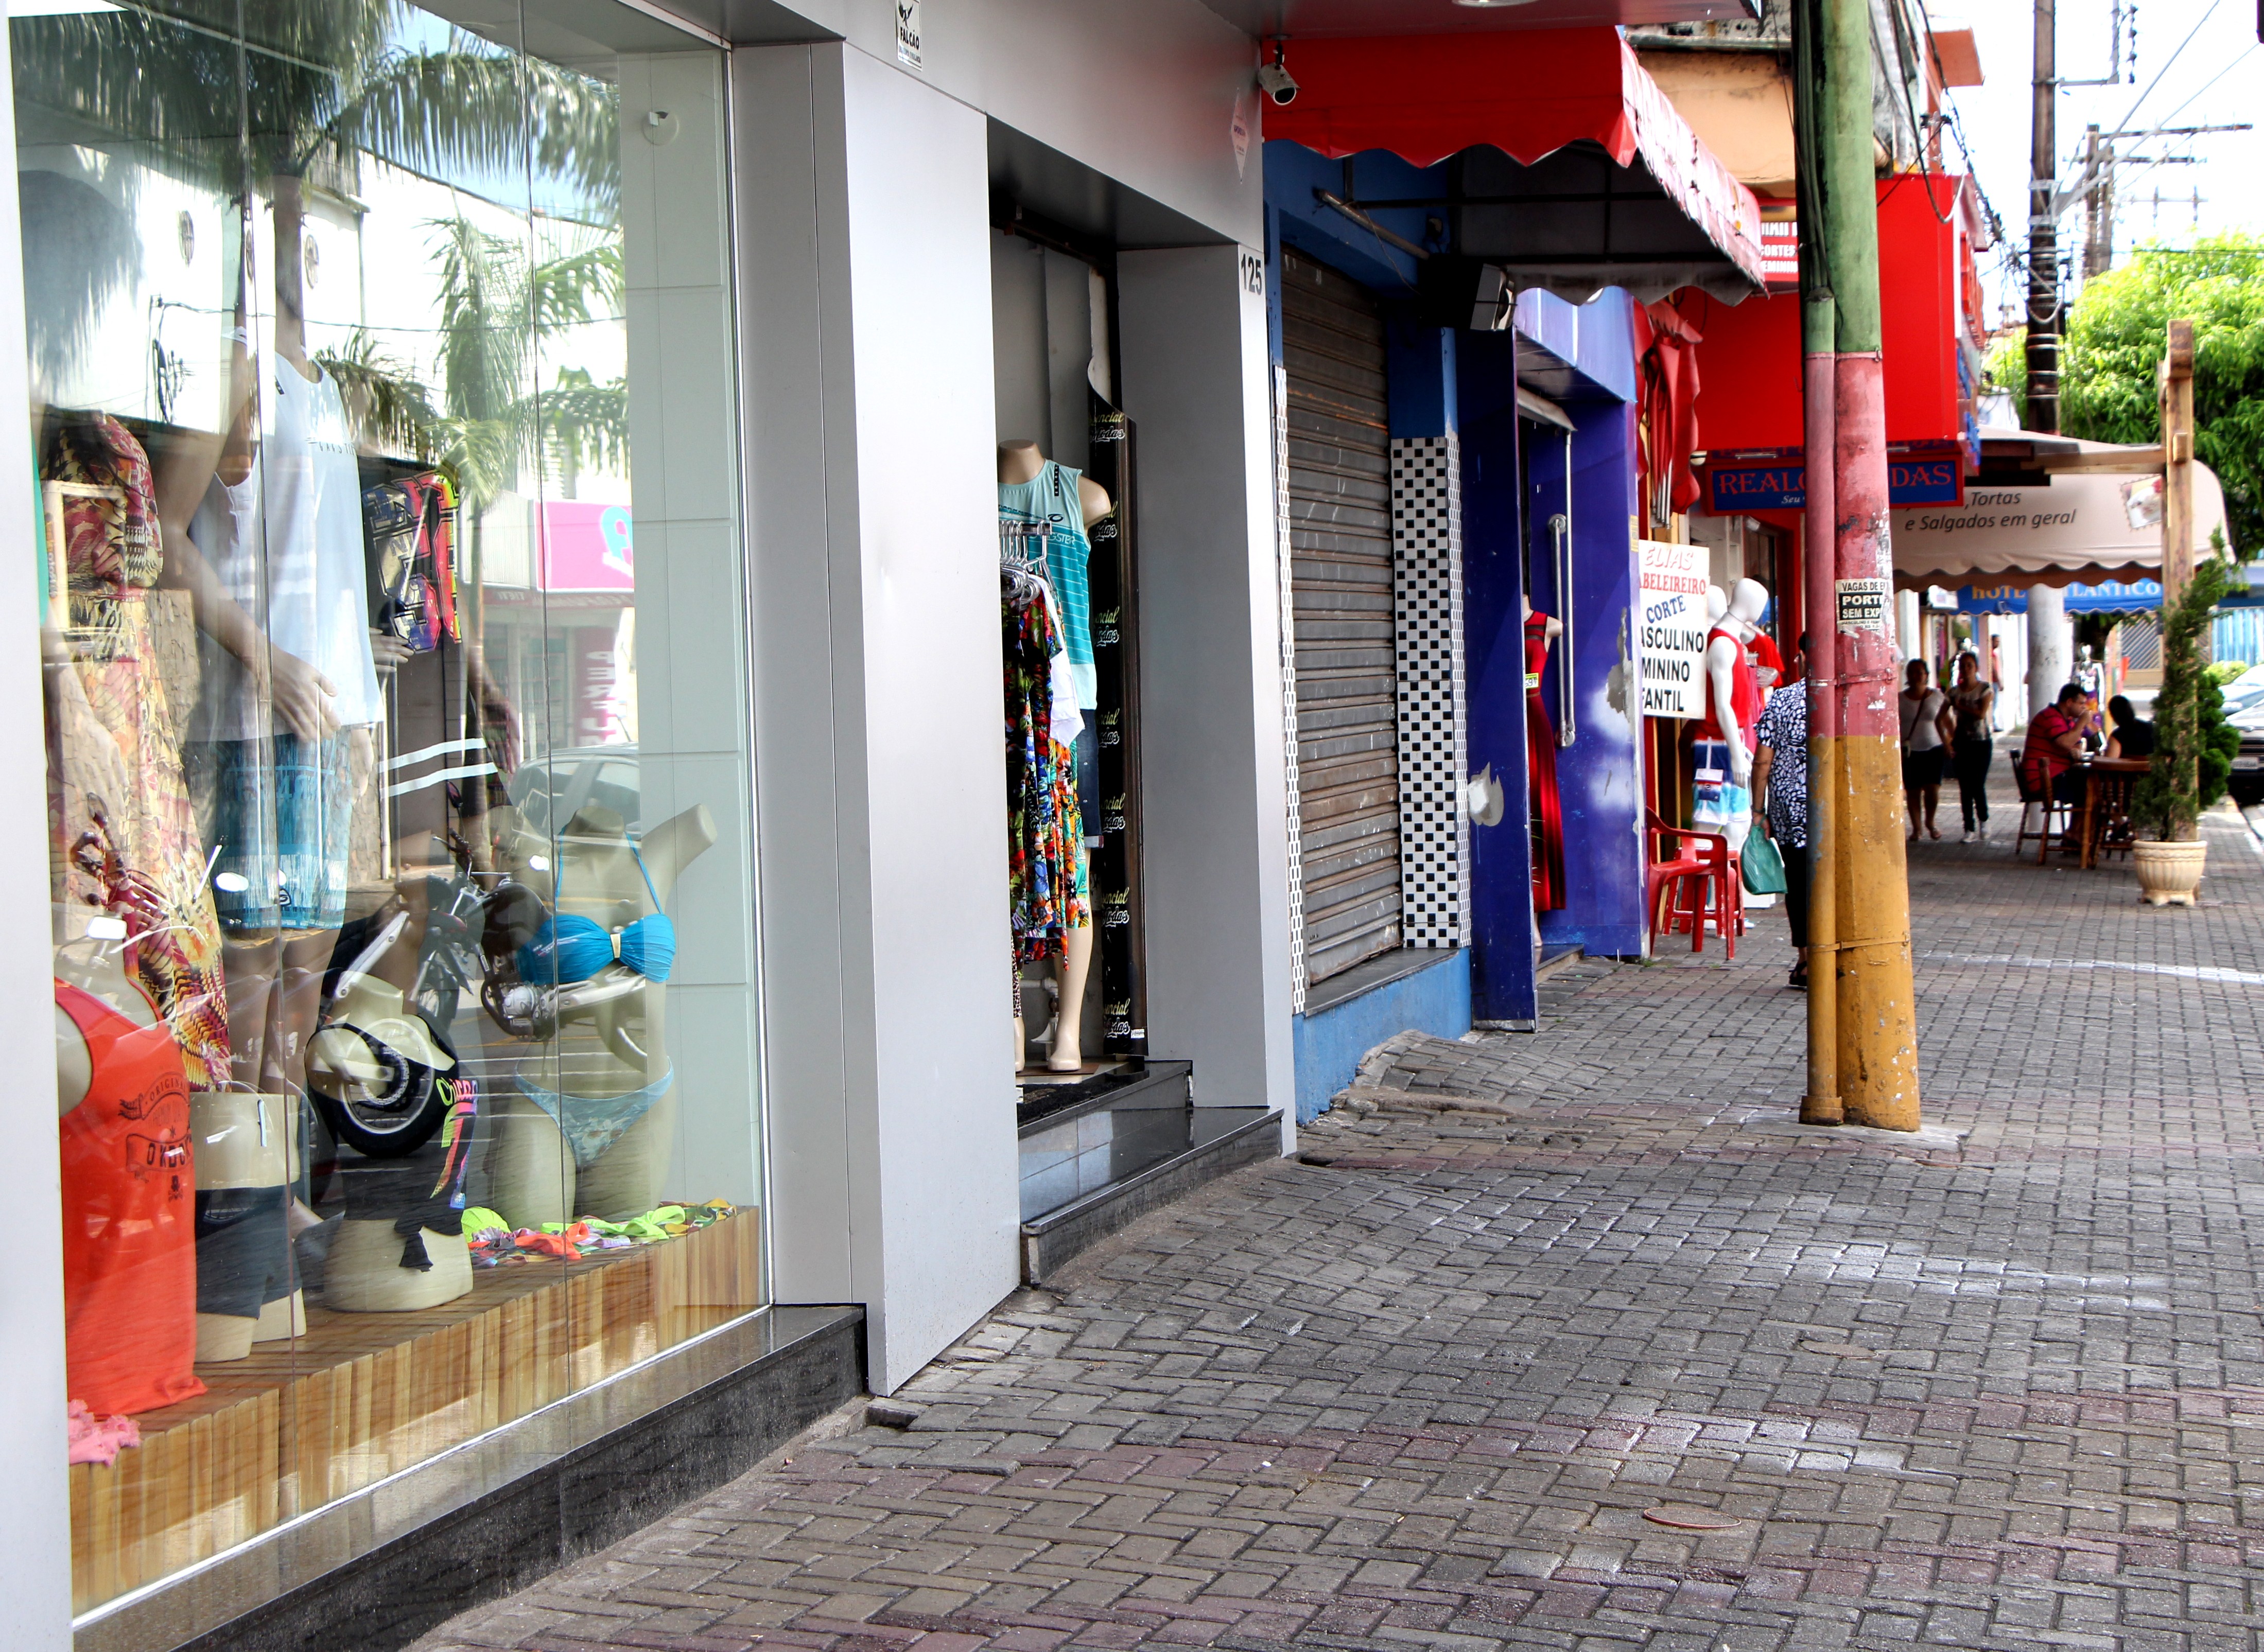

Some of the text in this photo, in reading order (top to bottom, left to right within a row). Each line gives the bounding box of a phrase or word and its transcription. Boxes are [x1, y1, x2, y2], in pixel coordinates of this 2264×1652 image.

[1241, 253, 1262, 295] 125
[1891, 465, 1952, 487] DAS
[1781, 495, 1800, 504] Seu
[1905, 508, 2077, 532] e Salgados em geral
[1645, 547, 1693, 571] ELIAS
[1842, 582, 1868, 591] VAGAS
[1870, 582, 1878, 590] DE
[1646, 595, 1686, 624] CORTE
[1842, 607, 1880, 618] SEM EXP
